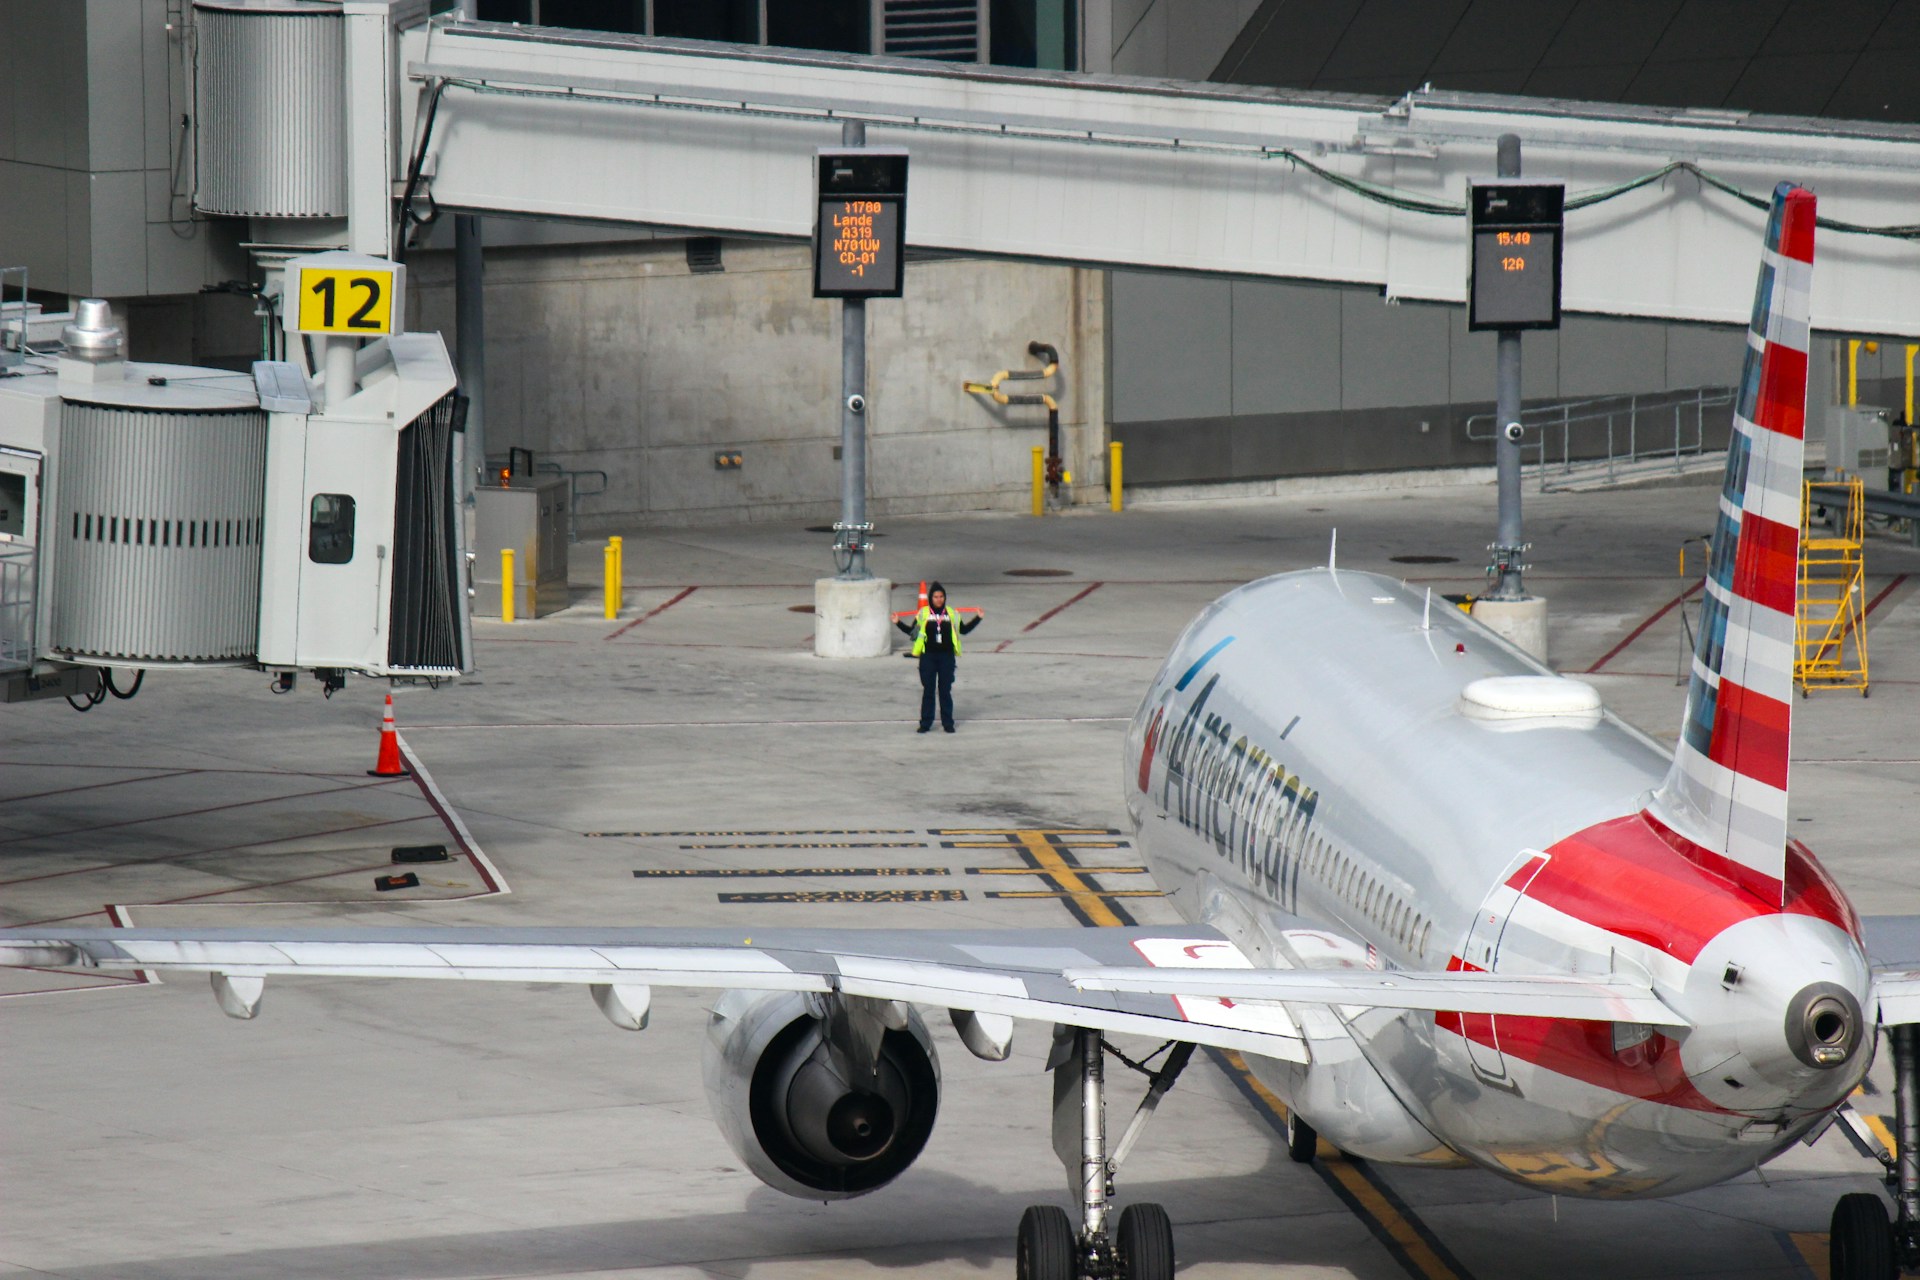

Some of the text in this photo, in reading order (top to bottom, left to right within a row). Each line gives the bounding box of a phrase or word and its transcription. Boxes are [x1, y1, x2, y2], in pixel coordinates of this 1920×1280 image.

[841, 226, 873, 239] A319
[1496, 231, 1531, 246] 15:40
[833, 238, 881, 251] N701UW
[839, 252, 876, 264] CD-01
[1502, 256, 1525, 271] 12A
[851, 264, 865, 277] -1
[311, 276, 381, 329] 12
[1163, 672, 1318, 917] American
